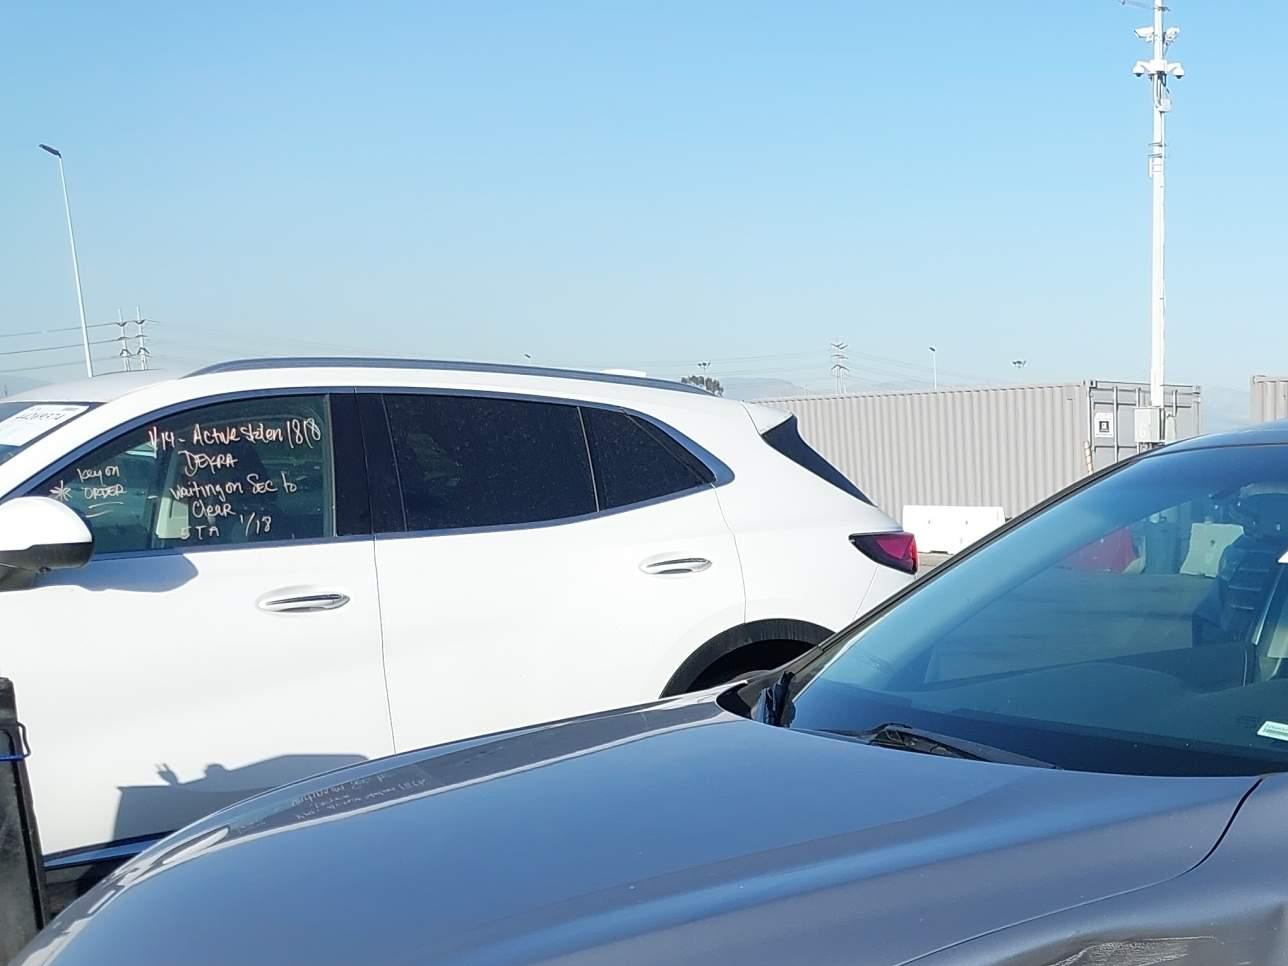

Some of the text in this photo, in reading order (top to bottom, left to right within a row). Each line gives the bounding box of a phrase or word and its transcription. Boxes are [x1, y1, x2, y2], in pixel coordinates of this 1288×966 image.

[225, 481, 244, 494] on
[281, 471, 298, 493] to
[240, 512, 272, 537] 1/18
